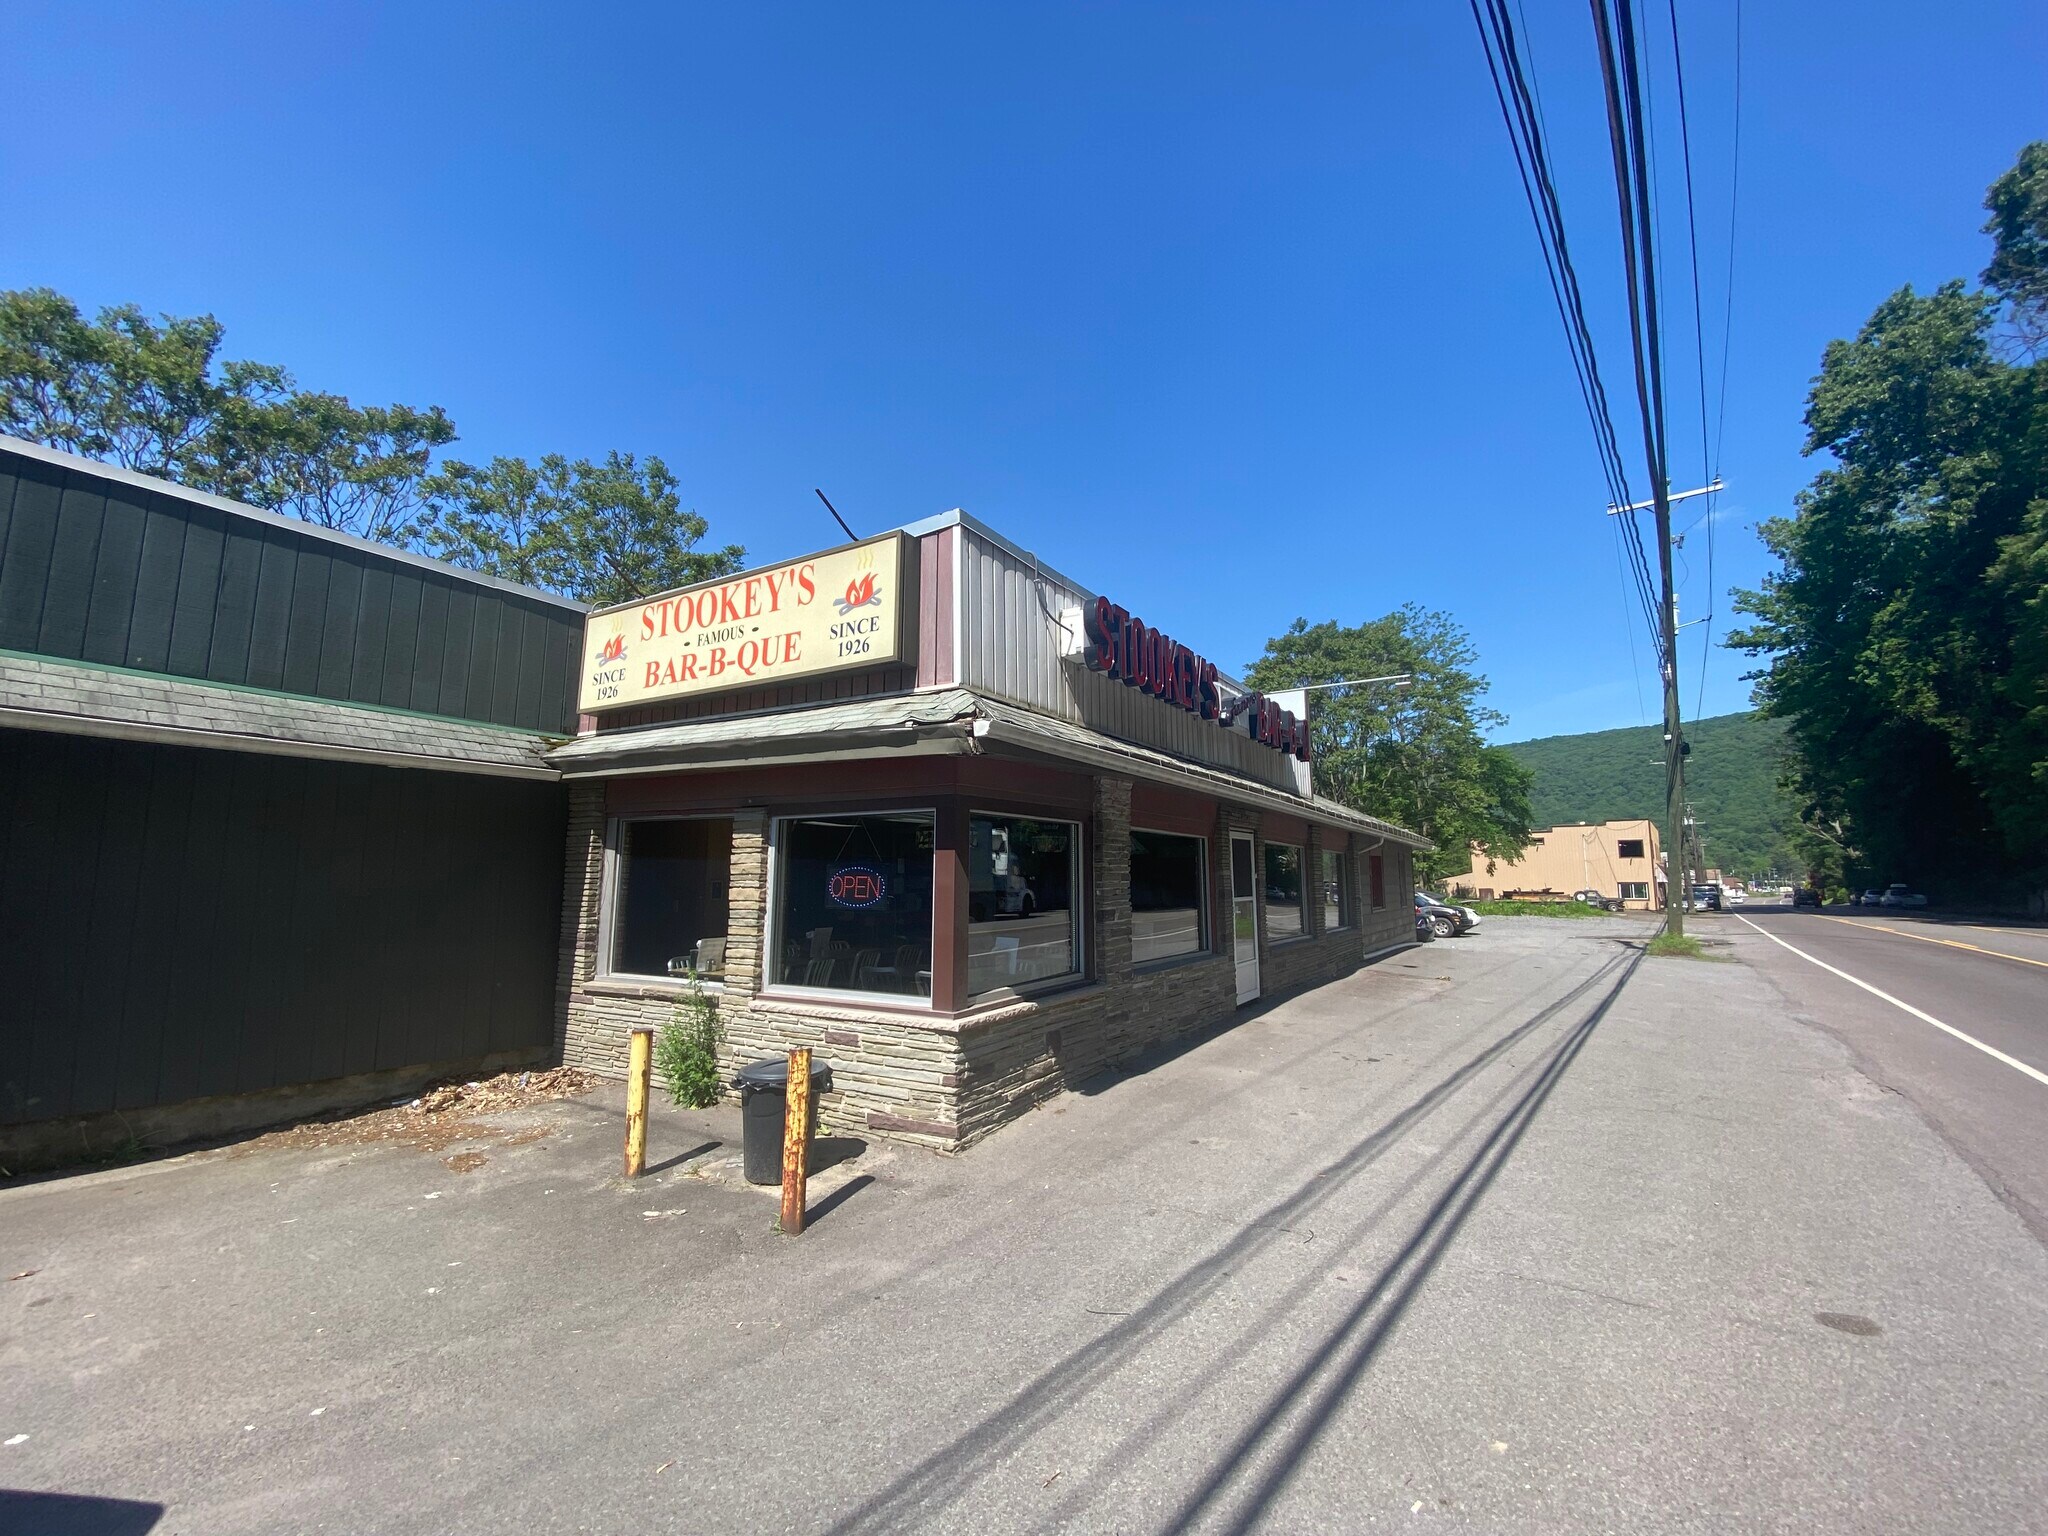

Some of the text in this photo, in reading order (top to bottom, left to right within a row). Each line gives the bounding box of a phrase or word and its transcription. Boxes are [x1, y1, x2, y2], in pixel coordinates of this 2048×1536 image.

[640, 562, 815, 642] STOOKEY'S
[697, 625, 745, 647] FAMOUS
[829, 616, 880, 640] SINCE
[837, 638, 870, 657] 1926
[1085, 596, 1219, 719] STOOKEY'S
[643, 631, 802, 689] BAR-B-QUE
[592, 668, 626, 686] SINCE
[597, 685, 618, 700] 1926
[832, 875, 880, 898] OPEN
